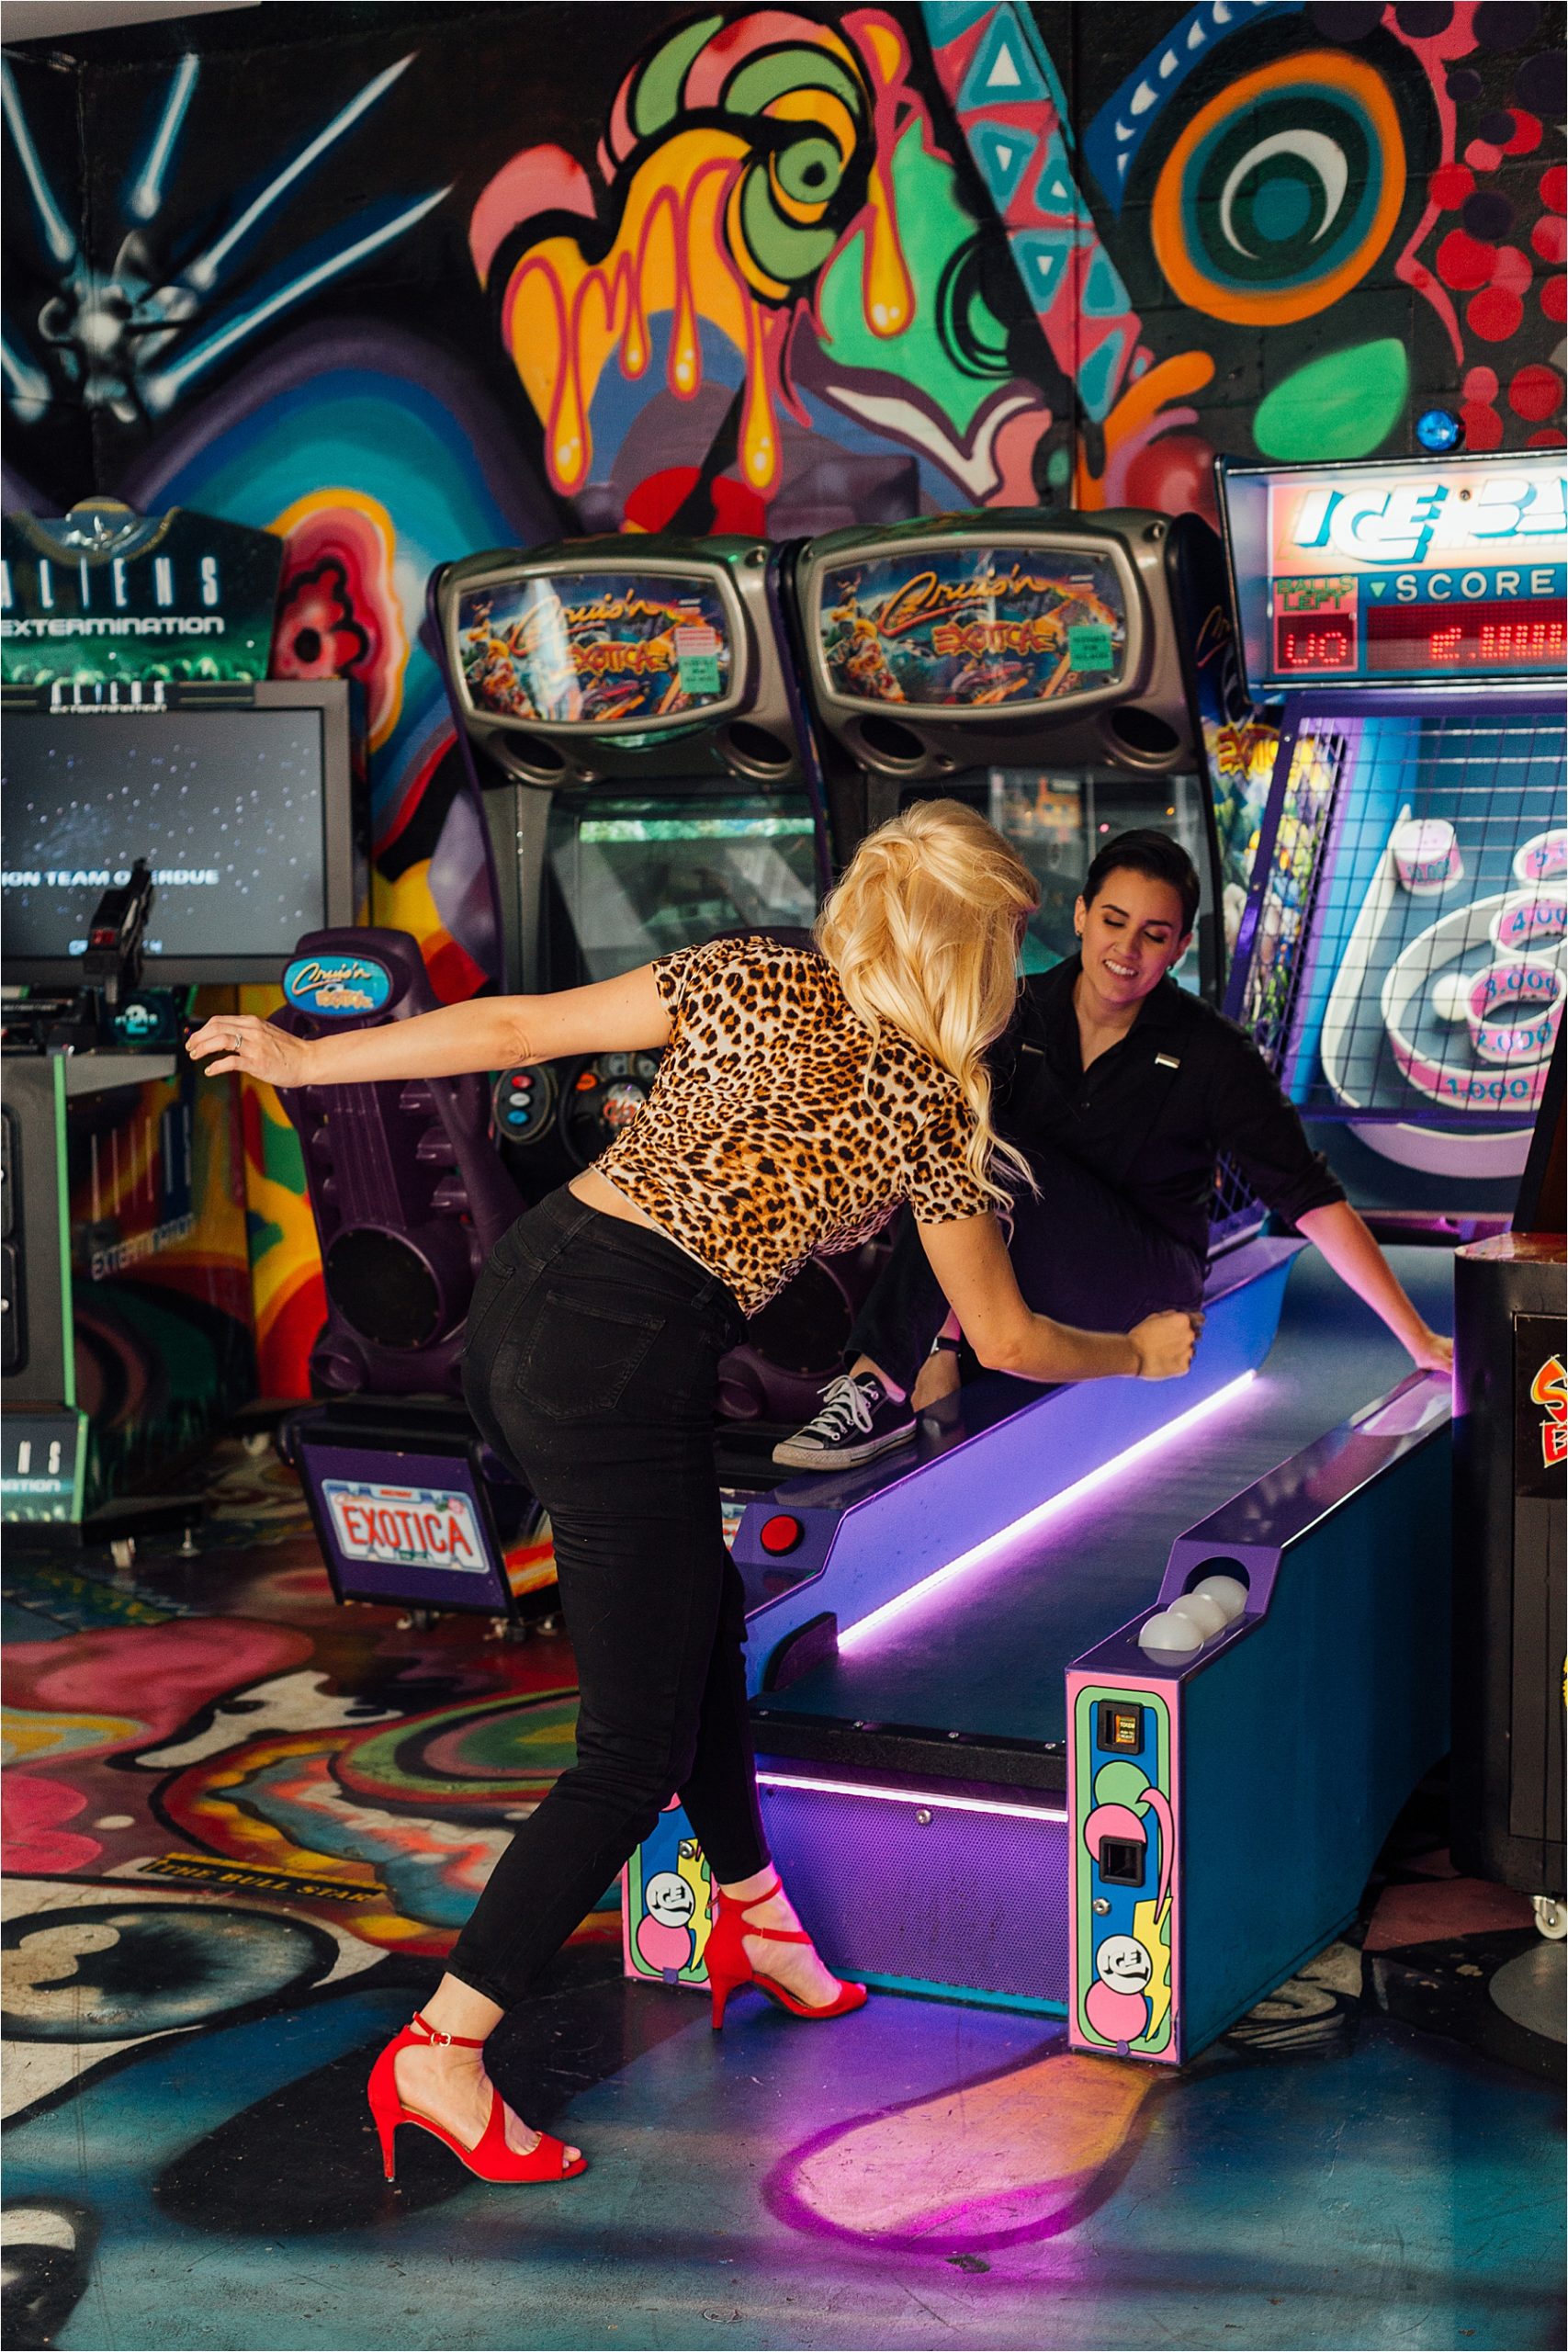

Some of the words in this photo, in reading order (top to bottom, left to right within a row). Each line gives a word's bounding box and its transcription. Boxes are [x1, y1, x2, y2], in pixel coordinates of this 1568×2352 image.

[1292, 486, 1450, 564] ICE
[876, 563, 1047, 637] Cruis'n
[1277, 575, 1355, 596] BALLS
[1283, 589, 1342, 611] LEFT
[1396, 569, 1555, 602] SCORE
[2, 616, 225, 637] EXTERMINATION
[932, 620, 1057, 657] EXOTICA
[549, 641, 671, 674] XOTICA
[46, 870, 110, 887] TEAM
[342, 1506, 473, 1556] EXOTICA
[161, 1863, 216, 1880] THE
[220, 1872, 291, 1892] BULL
[651, 1884, 694, 1917] ICE
[1102, 1948, 1150, 1982] ICE
